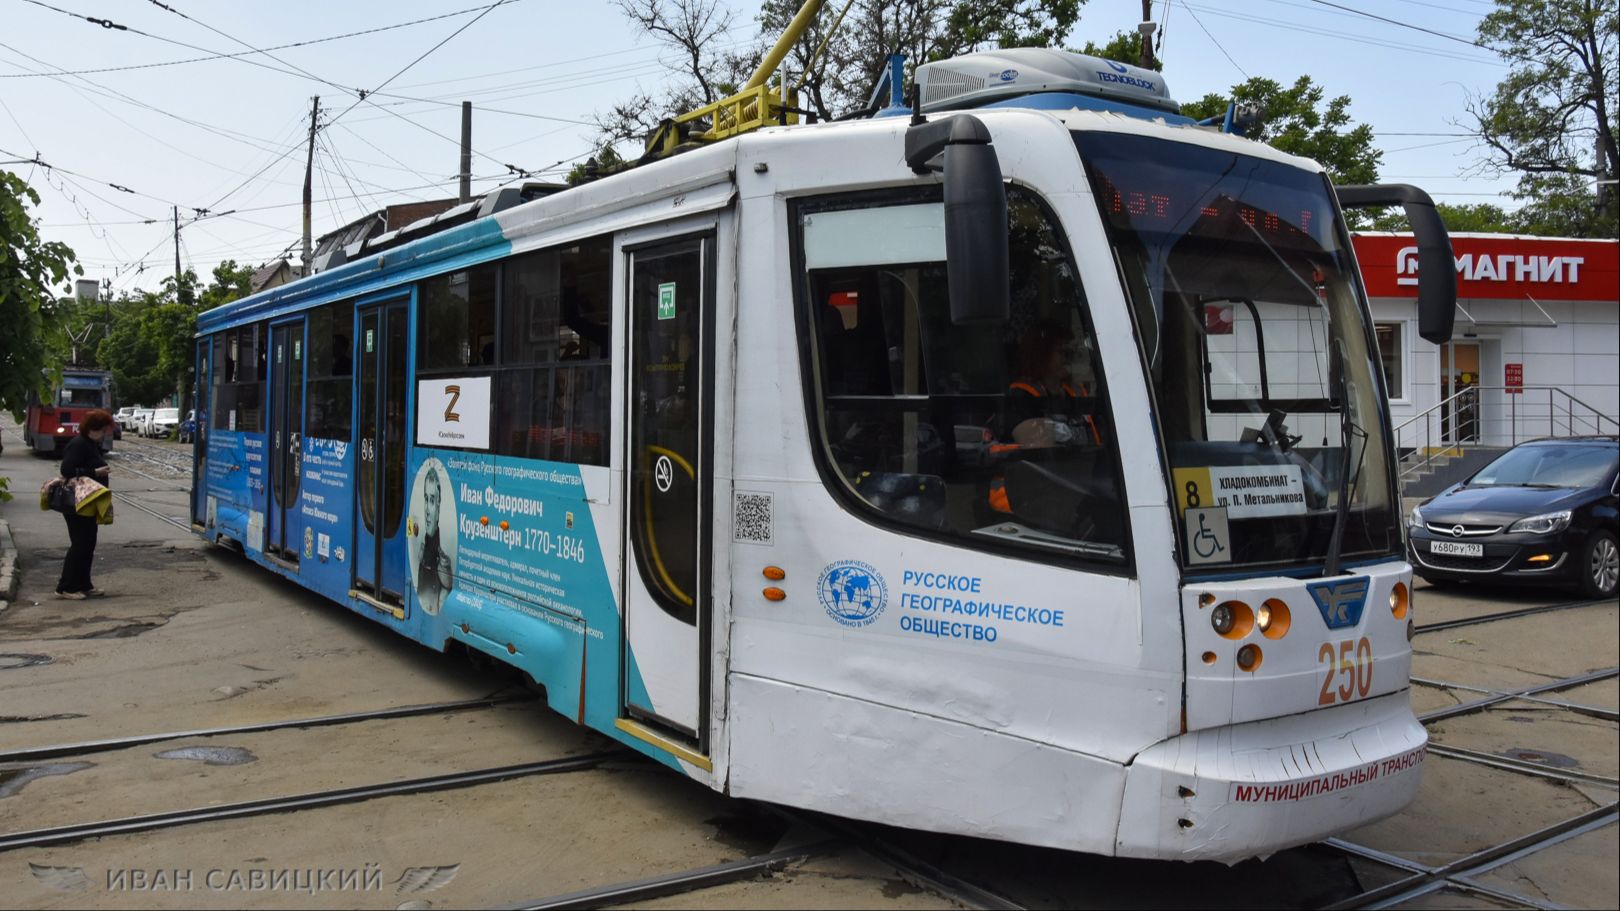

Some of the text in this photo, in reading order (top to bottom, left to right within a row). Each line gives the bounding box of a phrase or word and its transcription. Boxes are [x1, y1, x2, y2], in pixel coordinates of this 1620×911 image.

[1096, 71, 1155, 91] TECNOBLOCK
[445, 385, 460, 422] Z
[502, 466, 549, 481] географического
[1219, 475, 1288, 490] ХЛАДОКОМБИНАТ
[460, 482, 544, 517] Иван Федорович
[1186, 481, 1201, 508] 8
[1218, 493, 1304, 507] ул. П. Метальникова
[460, 513, 522, 551] Крузенштерн
[1433, 543, 1481, 553] У680РУ 193
[823, 559, 877, 573] ГЕОГРАФИЧЕСКОЕ
[875, 572, 889, 613] ОБЩЕСТВО
[903, 570, 981, 593] РУССКОЕ
[826, 609, 857, 628] ОСНОВАНО
[901, 593, 1064, 626] ГЕОГРАФИЧЕСКОЕ
[900, 615, 997, 642] ОБЩЕСТВО
[1318, 637, 1373, 705] 250
[1235, 761, 1378, 802] МУНИЦИПАЛЬНЫЙ
